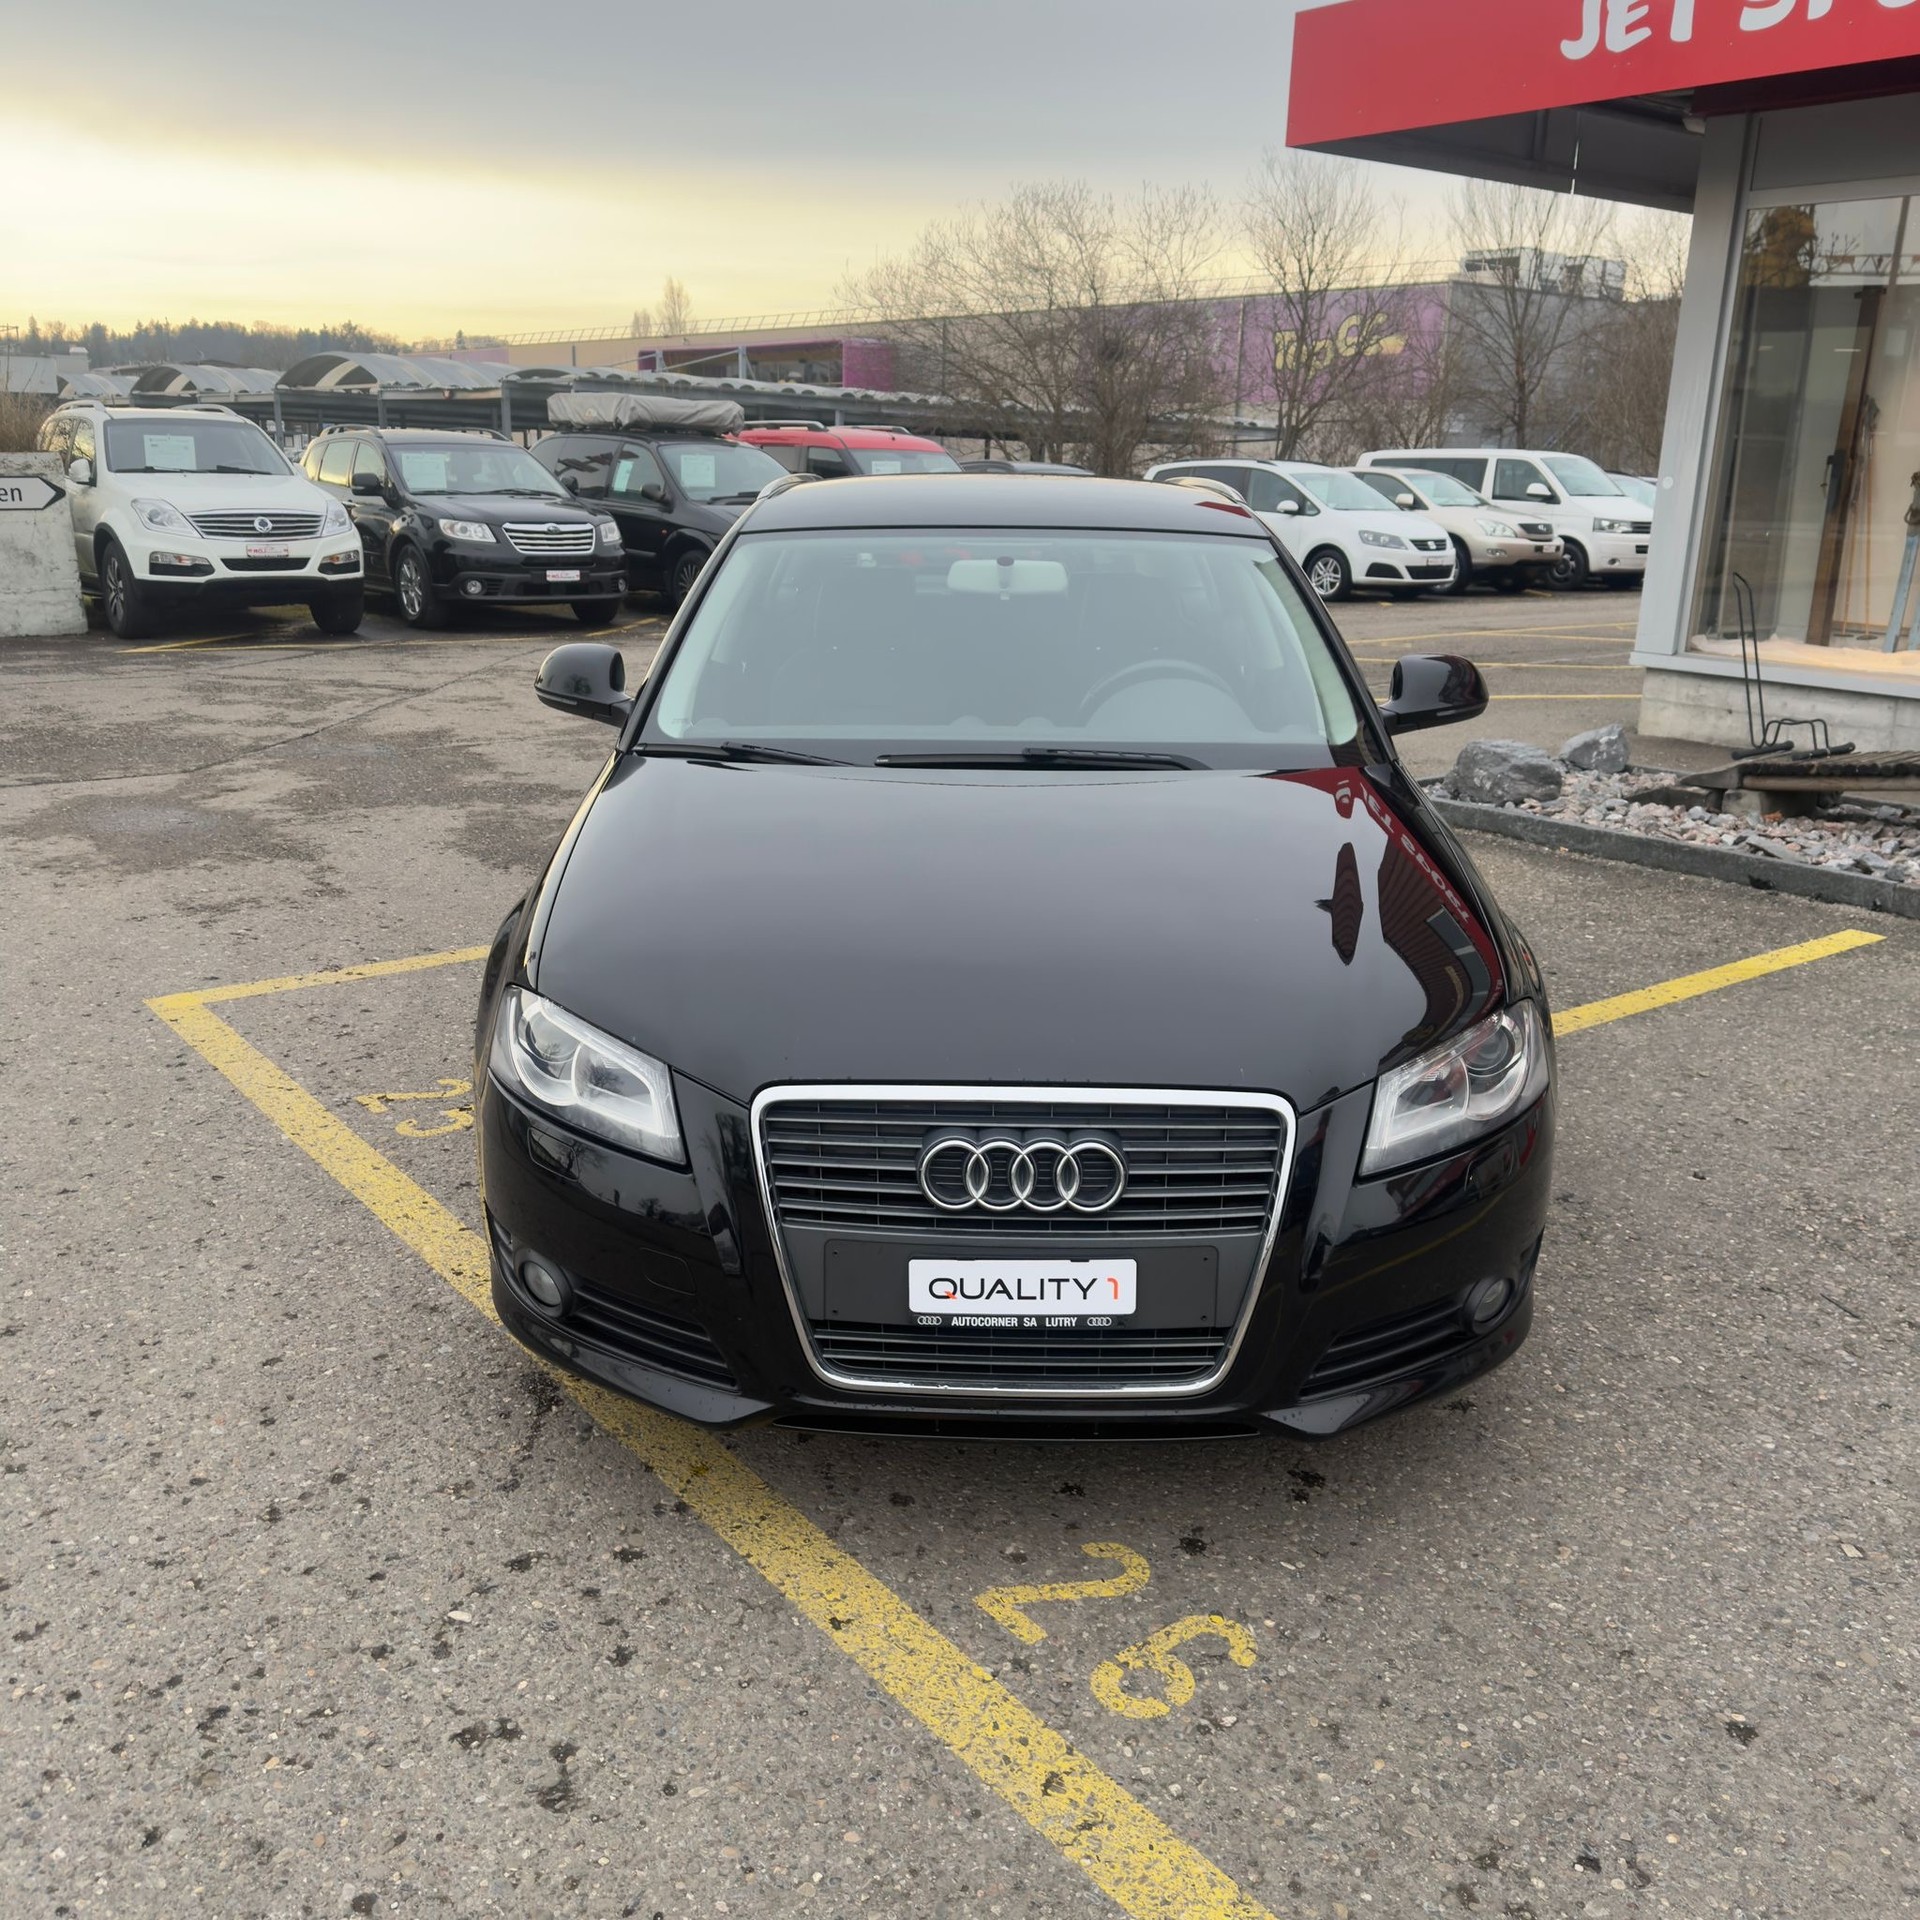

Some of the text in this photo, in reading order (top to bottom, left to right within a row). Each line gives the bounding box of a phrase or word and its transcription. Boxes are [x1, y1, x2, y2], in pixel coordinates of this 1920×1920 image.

[928, 1277, 1098, 1300] QUALITY
[951, 1316, 1077, 1327] AUTOCORNER SA LUTRY
